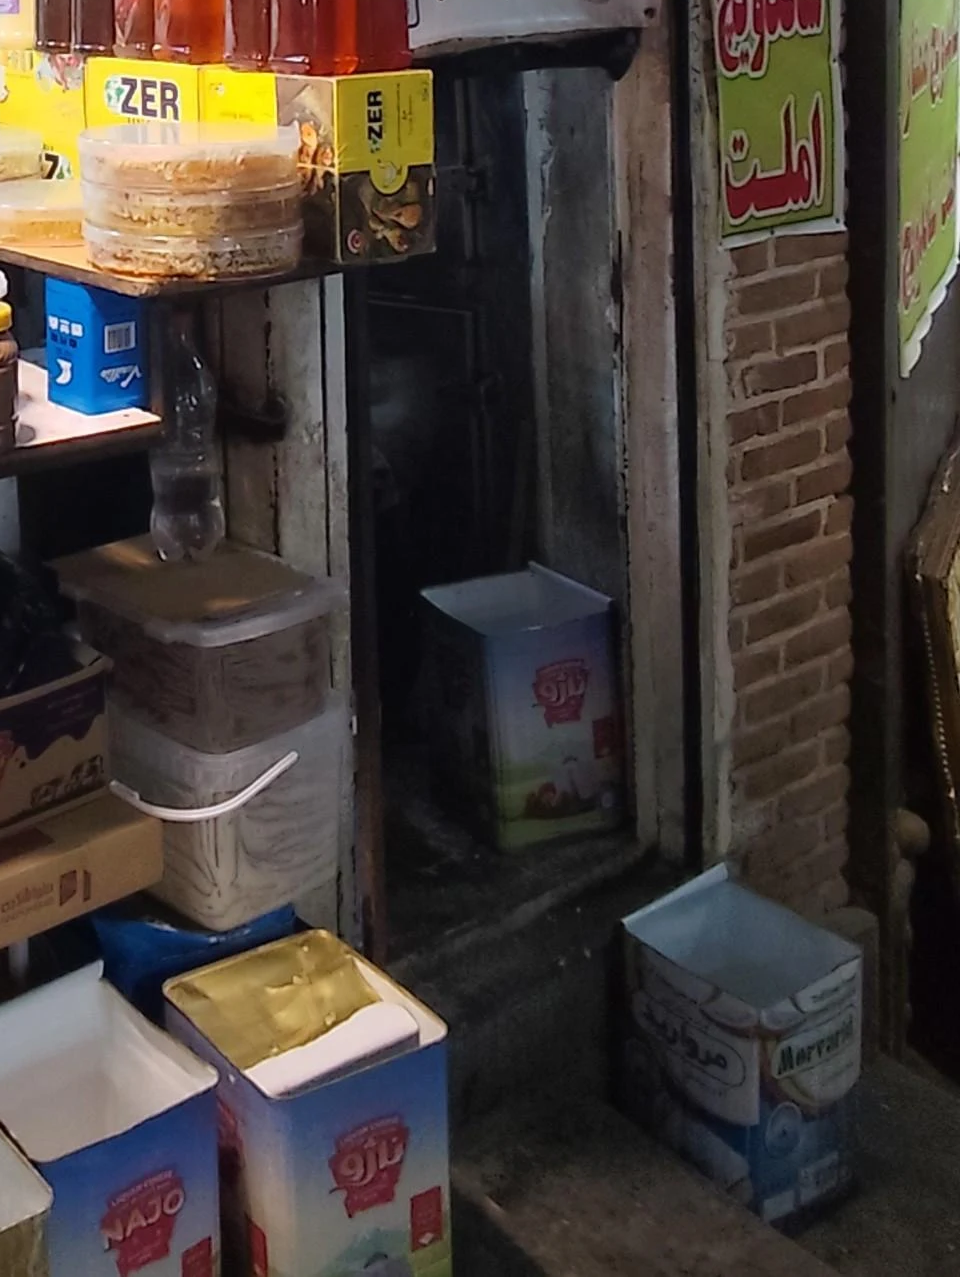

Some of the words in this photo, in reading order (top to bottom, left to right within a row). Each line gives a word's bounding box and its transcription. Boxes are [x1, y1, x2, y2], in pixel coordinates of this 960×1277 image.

[120, 77, 181, 122] ZER
[367, 90, 383, 141] ZER
[725, 97, 823, 220] املت
[100, 1188, 185, 1251] NAJO
